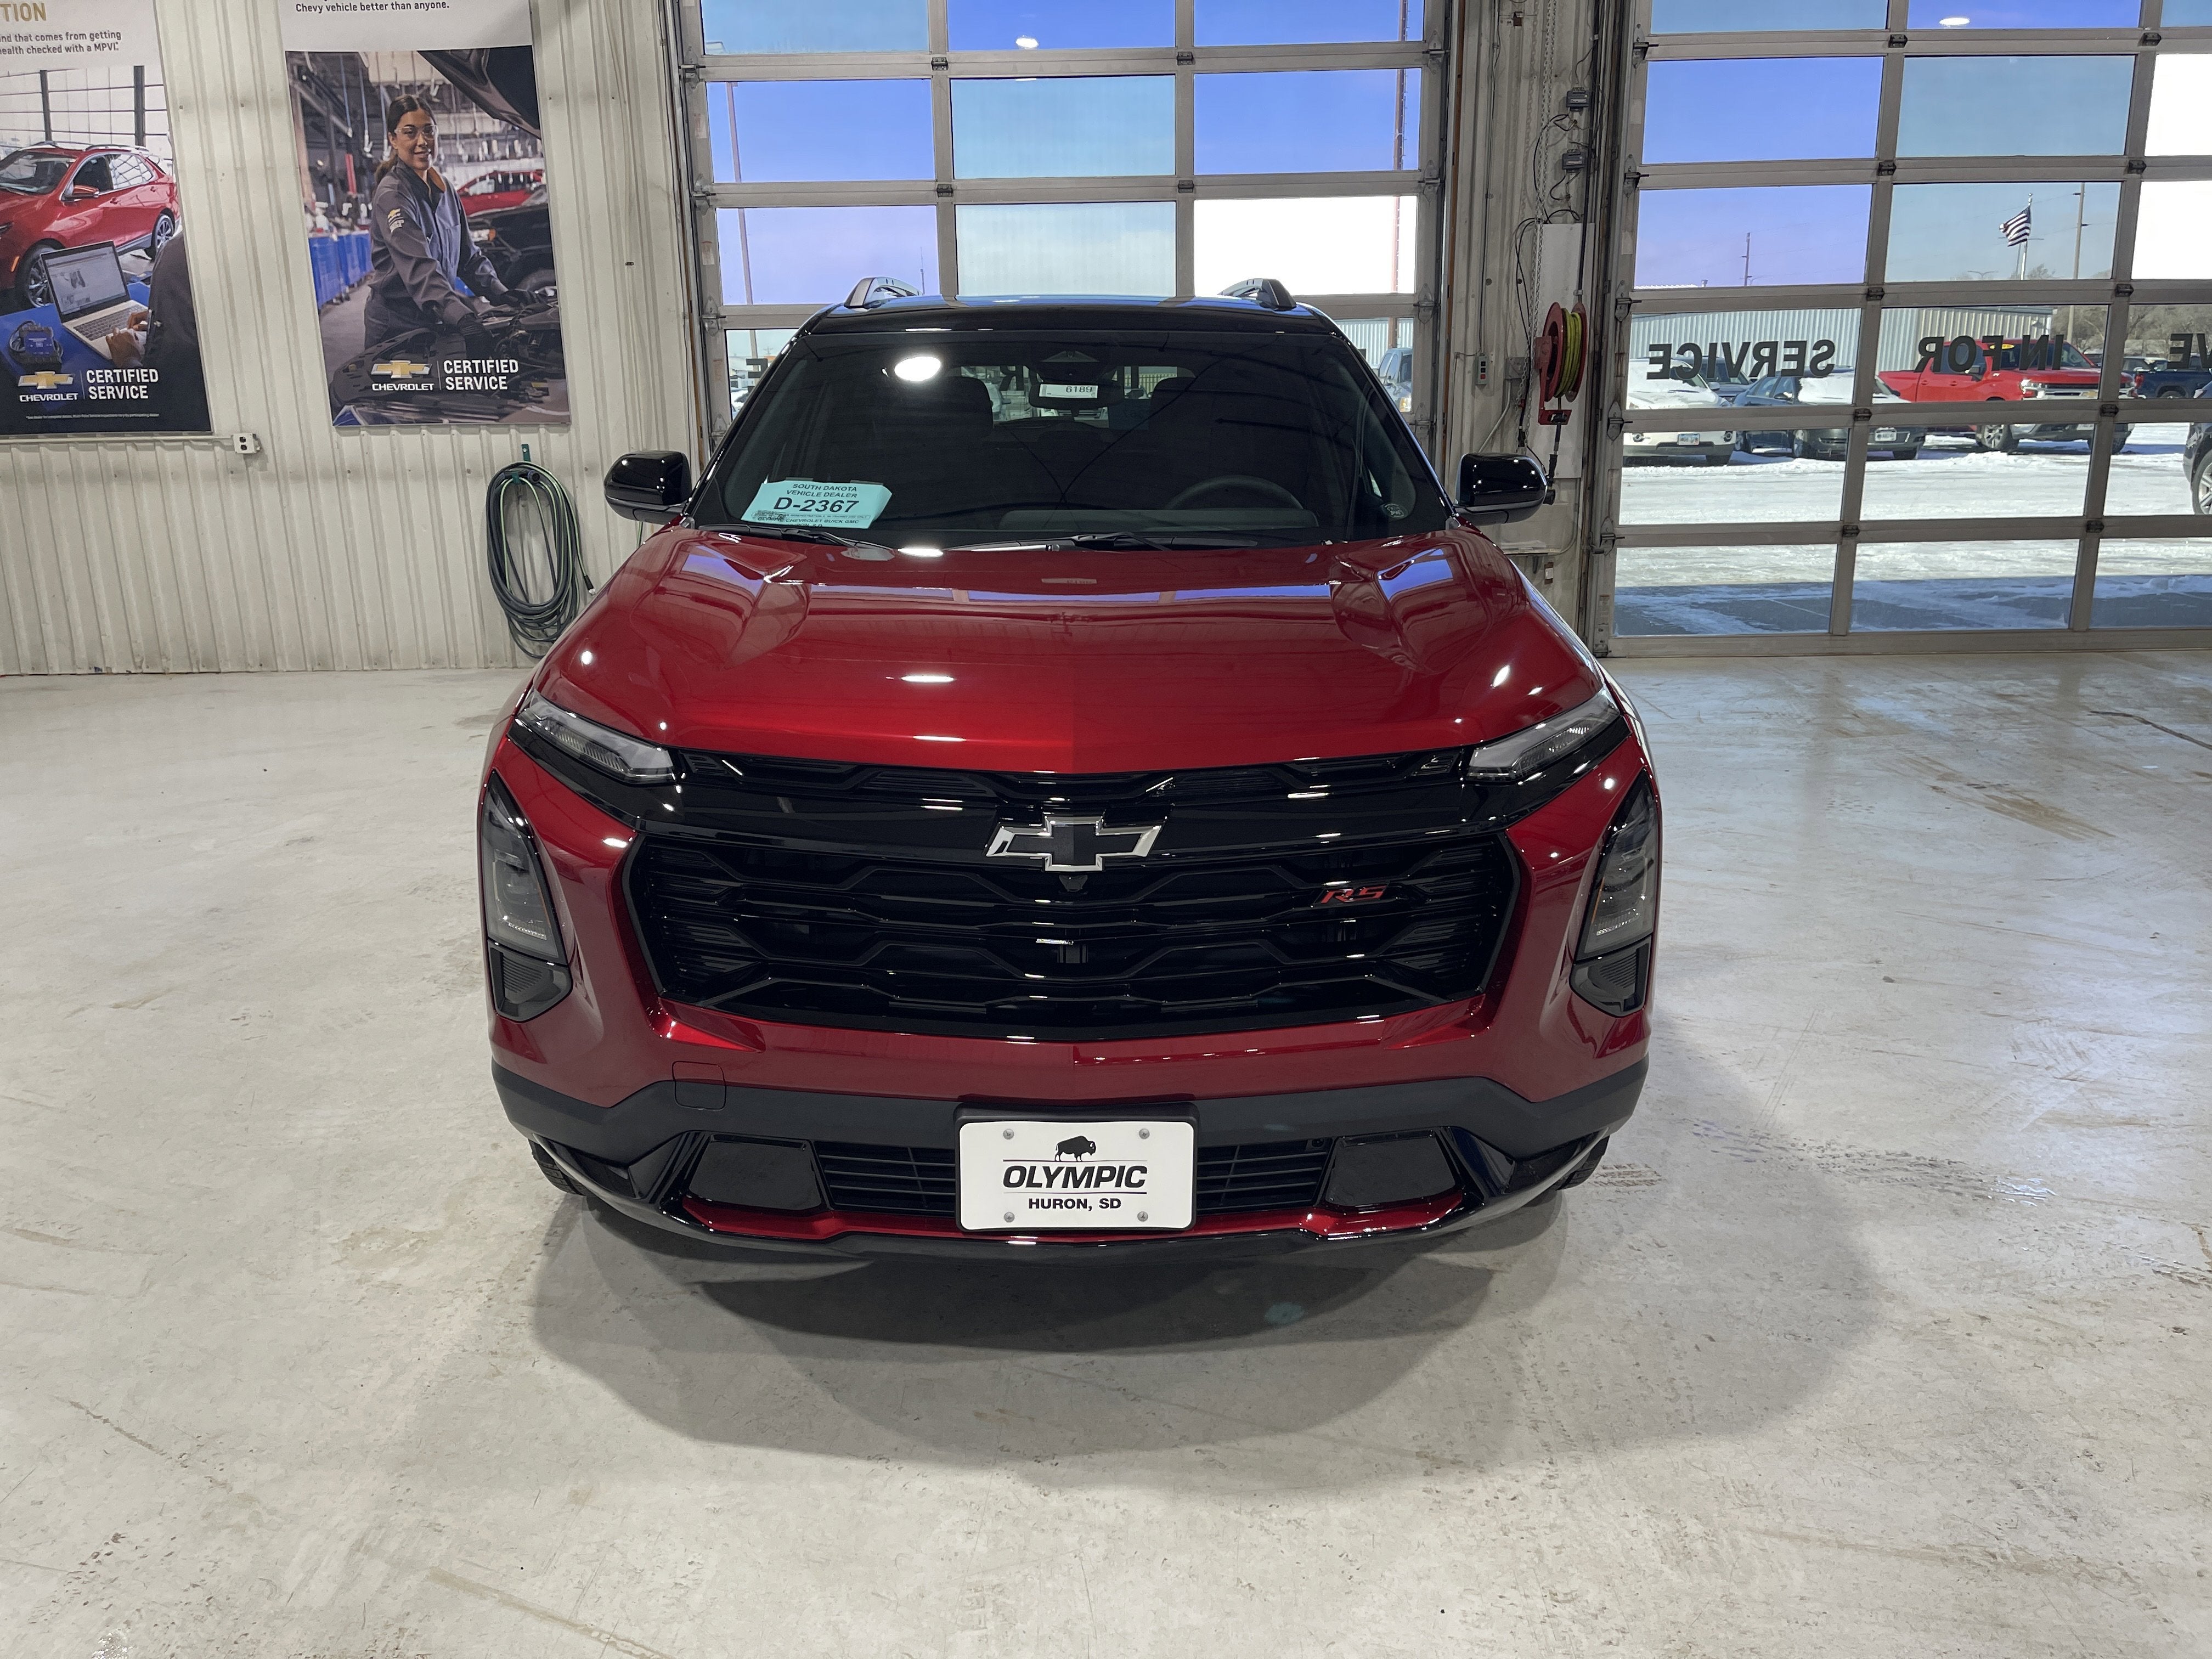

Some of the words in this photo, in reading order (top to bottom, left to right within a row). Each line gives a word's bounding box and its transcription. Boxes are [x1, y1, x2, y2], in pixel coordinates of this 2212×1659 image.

[296, 3, 323, 14] Chevy
[326, 2, 358, 12] vehicle
[360, 2, 388, 11] better
[391, 2, 411, 10] than
[414, 1, 450, 11] anyone.
[15, 33, 33, 42] that
[35, 33, 63, 42] comes
[65, 32, 87, 41] from
[89, 30, 121, 42] getting
[26, 44, 62, 54] checked
[65, 44, 84, 53] with
[443, 359, 519, 374] CERTIFIED
[86, 369, 159, 383] CERTIFIED
[371, 383, 435, 391] CHEVROLET
[445, 376, 508, 391] SERVICE
[19, 393, 79, 402] CHEVROLET
[88, 386, 149, 400] SERVICE
[774, 497, 860, 513] D-2367
[1321, 885, 1387, 904] RS
[1003, 1165, 1148, 1188] OLYMPIC
[1029, 1198, 1092, 1211] HURON,
[1099, 1198, 1121, 1209] SD
